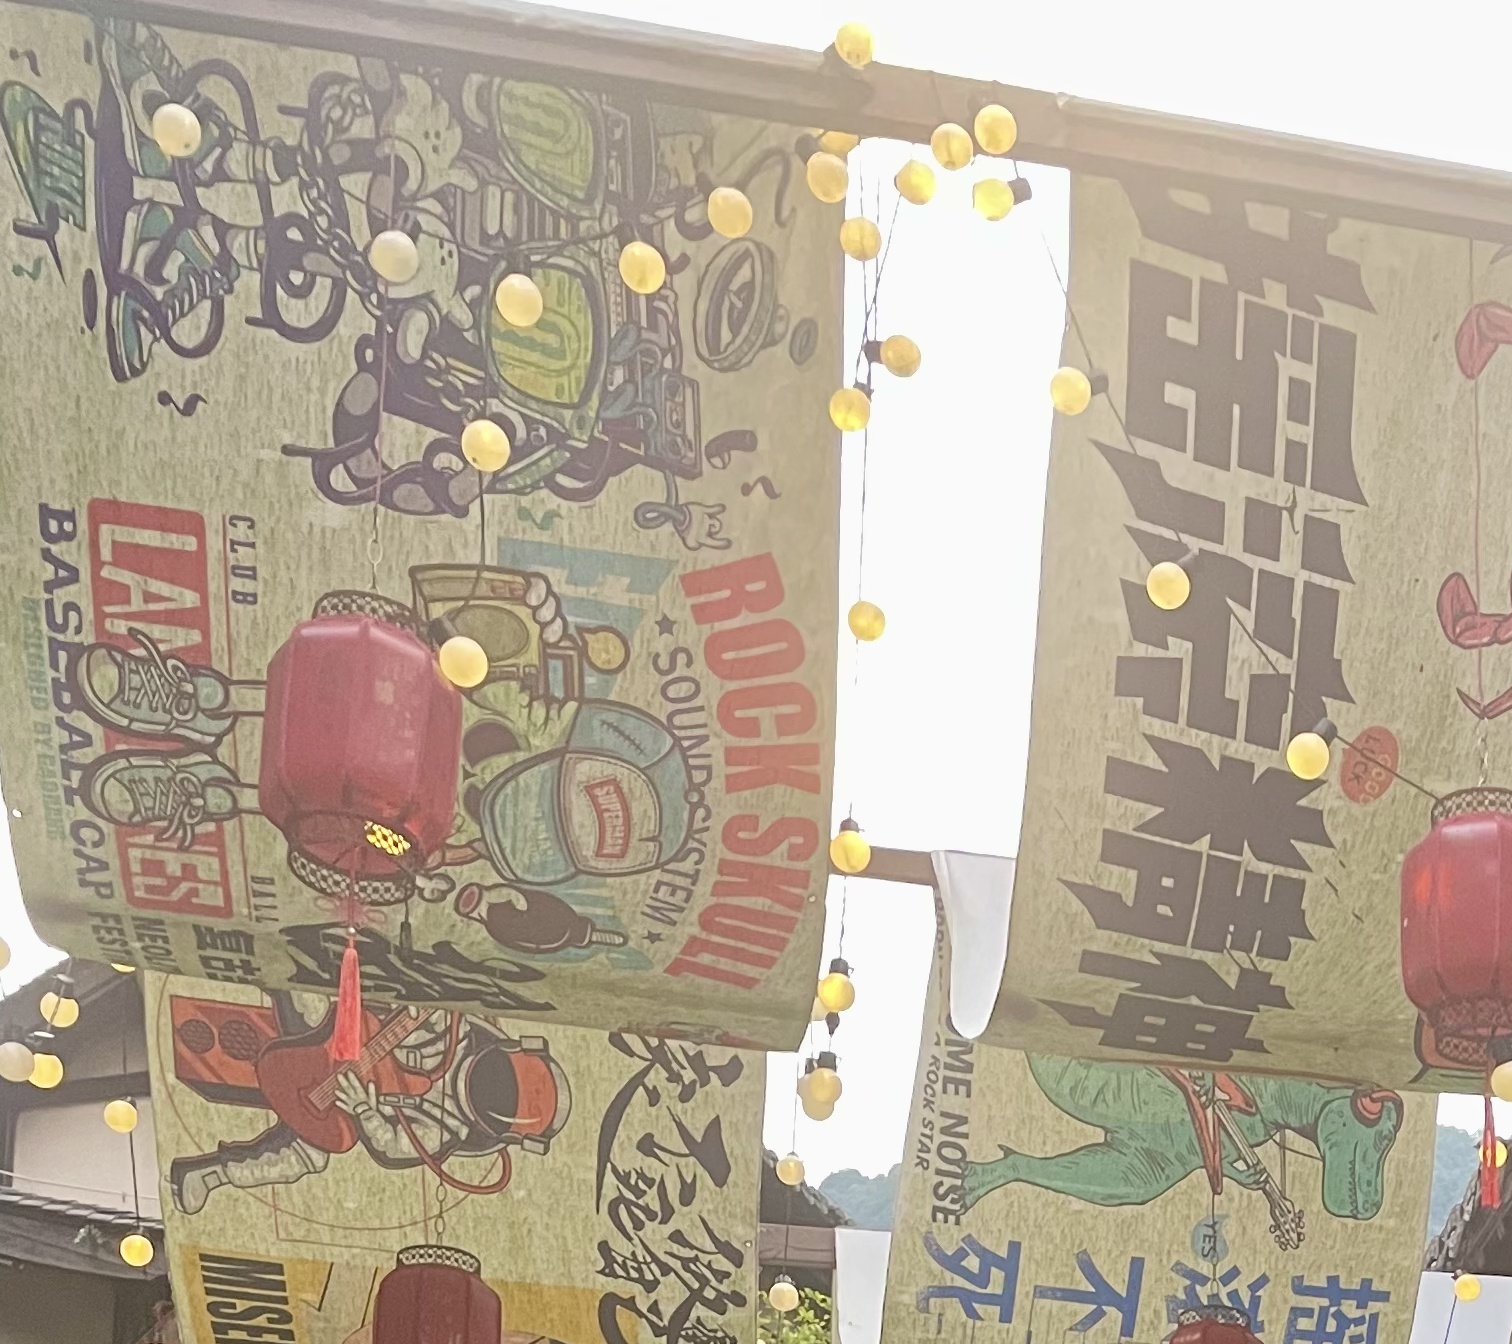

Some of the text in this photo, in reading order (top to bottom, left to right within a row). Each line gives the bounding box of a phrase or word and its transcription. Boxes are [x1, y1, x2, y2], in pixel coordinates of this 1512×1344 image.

[228, 515, 258, 606] CLUB
[1040, 173, 1379, 1057] 摇滚精神
[651, 647, 713, 790] SOUND
[663, 552, 822, 990] ROCK SKULL
[70, 820, 115, 899] CAP
[921, 1054, 941, 1114] ROCK
[914, 1117, 934, 1172] STAR
[931, 1111, 971, 1226] NOISE
[1201, 1221, 1220, 1259] YES
